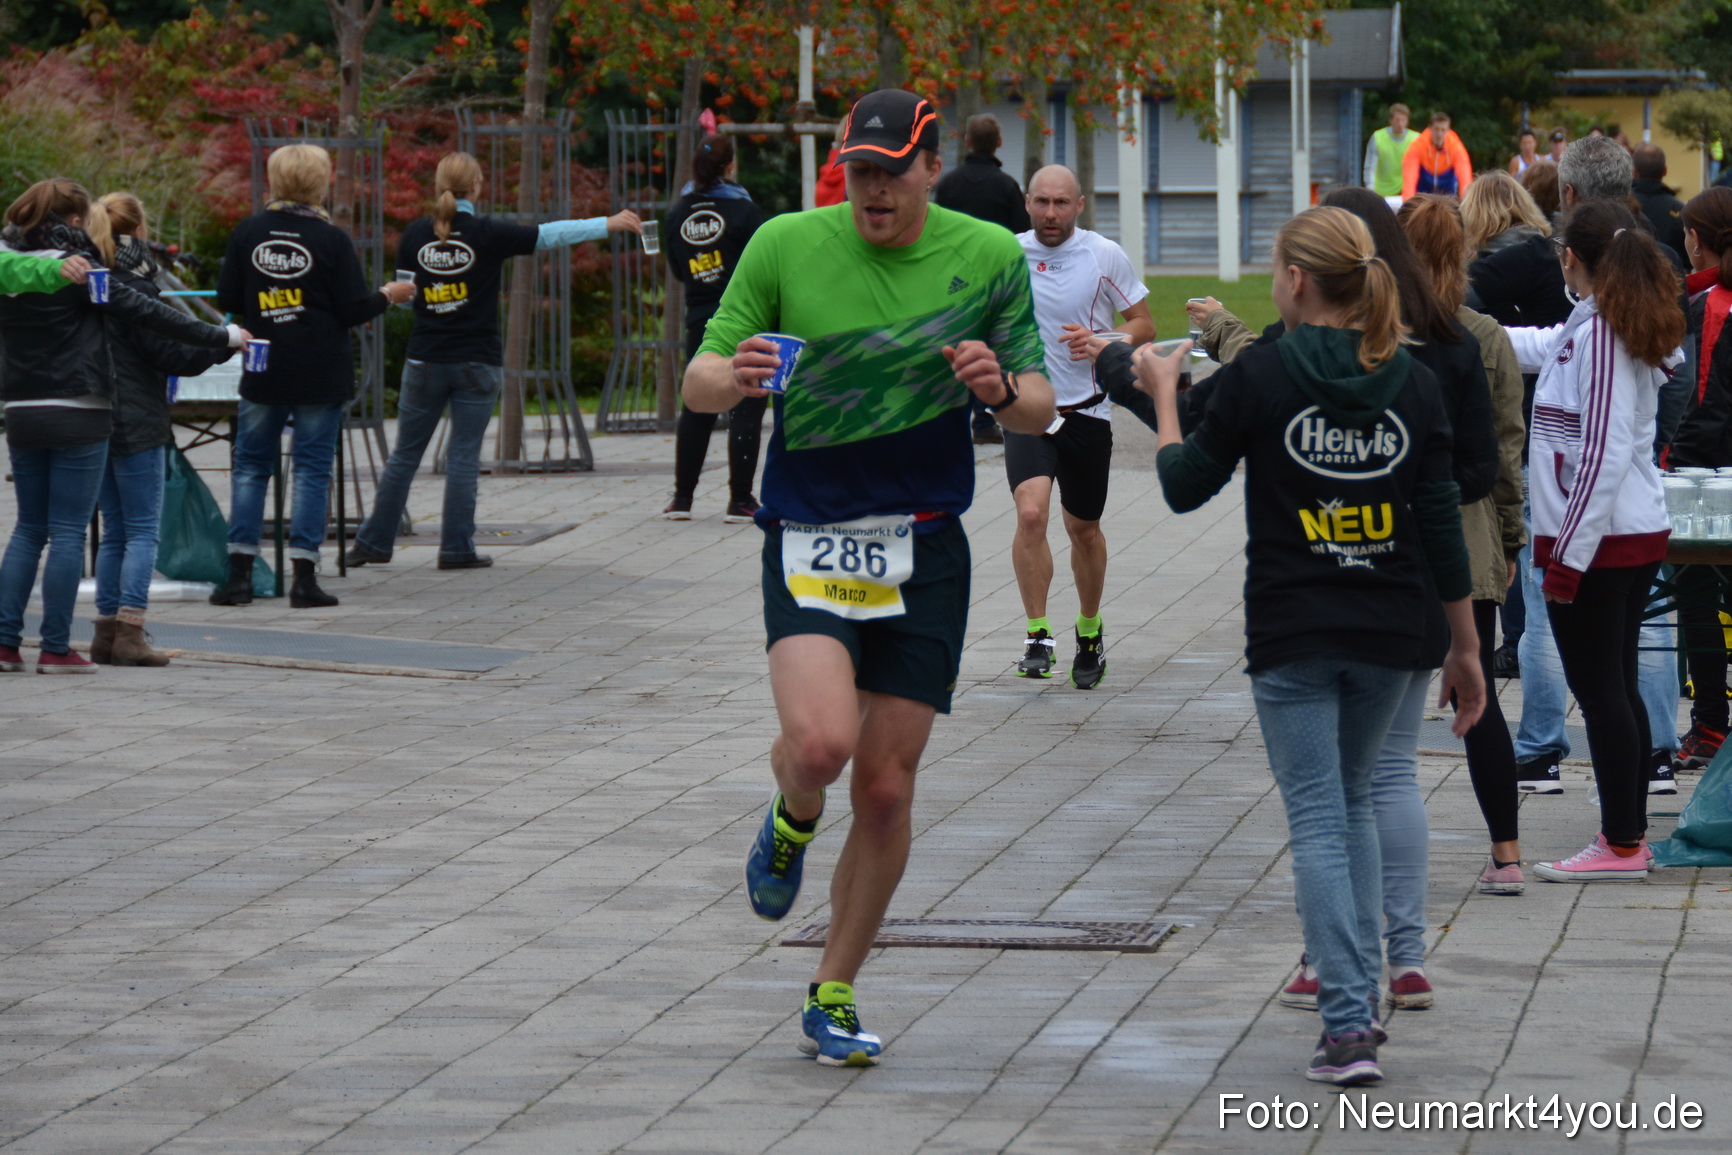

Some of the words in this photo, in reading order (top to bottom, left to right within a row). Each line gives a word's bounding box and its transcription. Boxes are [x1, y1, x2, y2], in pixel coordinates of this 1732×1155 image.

[258, 247, 306, 270] Hervis
[424, 247, 469, 267] Hervis
[689, 250, 722, 274] NEU
[258, 288, 302, 310] NEU
[423, 282, 467, 303] NEU
[1300, 418, 1397, 462] Hervis
[1308, 453, 1357, 464] SPORTS
[832, 526, 890, 537] Neumarkt
[1298, 503, 1393, 542] NEU
[811, 536, 887, 578] 286
[1310, 543, 1325, 554] IN
[824, 583, 867, 603] Marco
